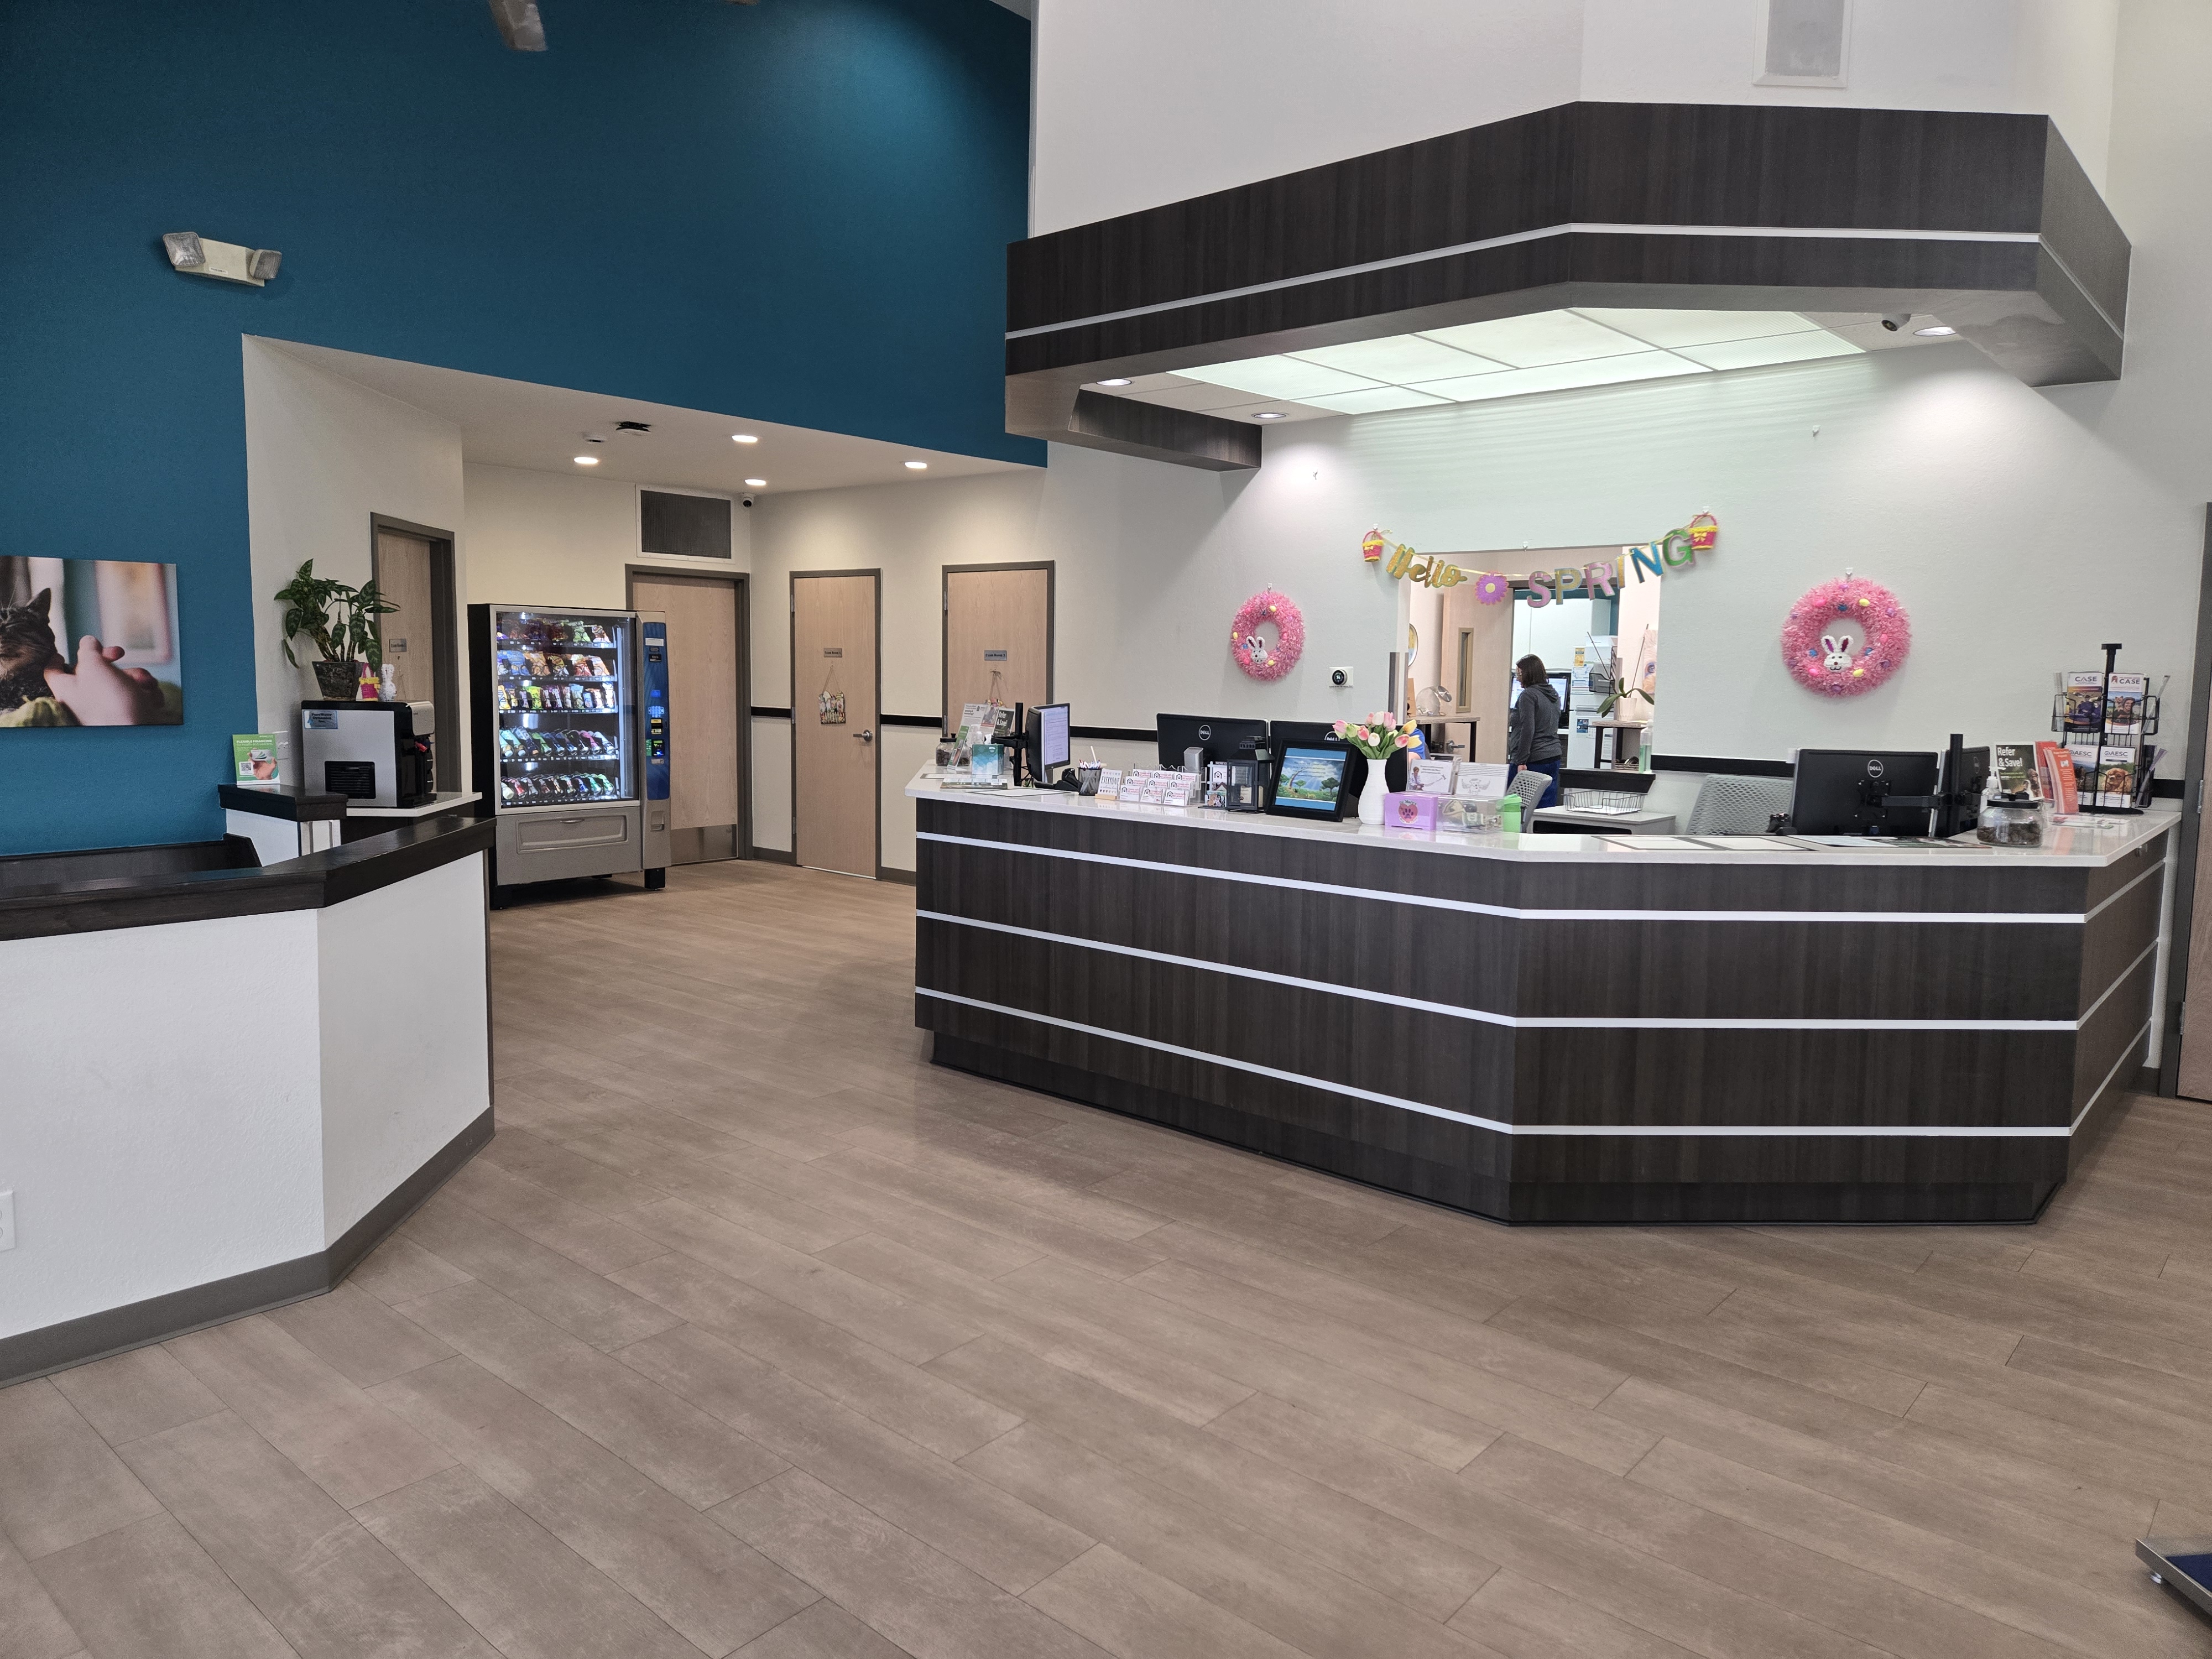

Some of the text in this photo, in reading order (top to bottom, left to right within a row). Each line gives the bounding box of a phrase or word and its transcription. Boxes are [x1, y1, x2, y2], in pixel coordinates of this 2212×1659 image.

[1386, 529, 1697, 608] Hello SPRING
[1997, 747, 2016, 756] Refer
[1999, 757, 2023, 767] & Save!
[1101, 776, 1120, 785] EVERYONE
